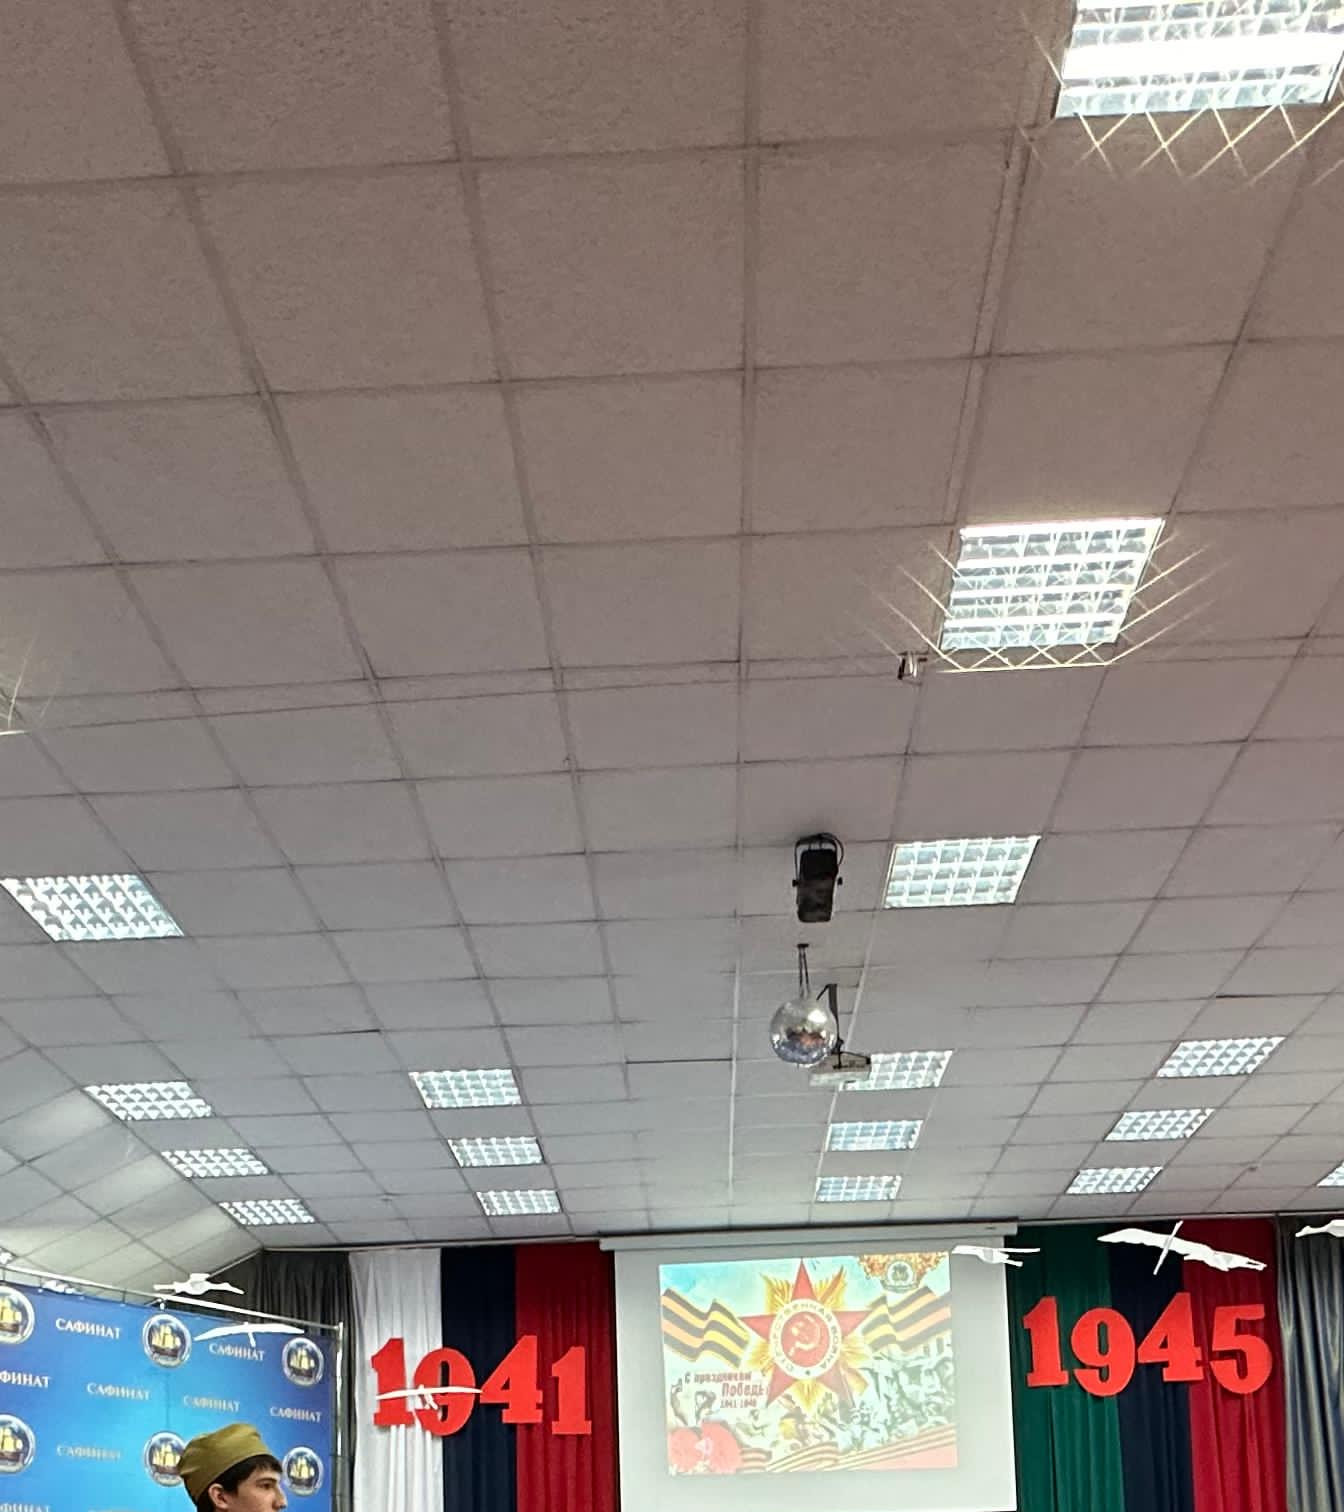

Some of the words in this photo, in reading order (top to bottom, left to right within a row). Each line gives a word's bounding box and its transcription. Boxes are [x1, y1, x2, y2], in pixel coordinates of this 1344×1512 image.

[56, 1318, 122, 1340] САФИНАТ
[209, 1343, 265, 1361] САФИНАТ
[1022, 1292, 1273, 1397] 1945
[86, 1382, 151, 1400] САФИНАТ
[371, 1335, 593, 1437] 1941
[183, 1395, 240, 1412] САФИНАТ
[270, 1406, 322, 1423] САФИНАТ
